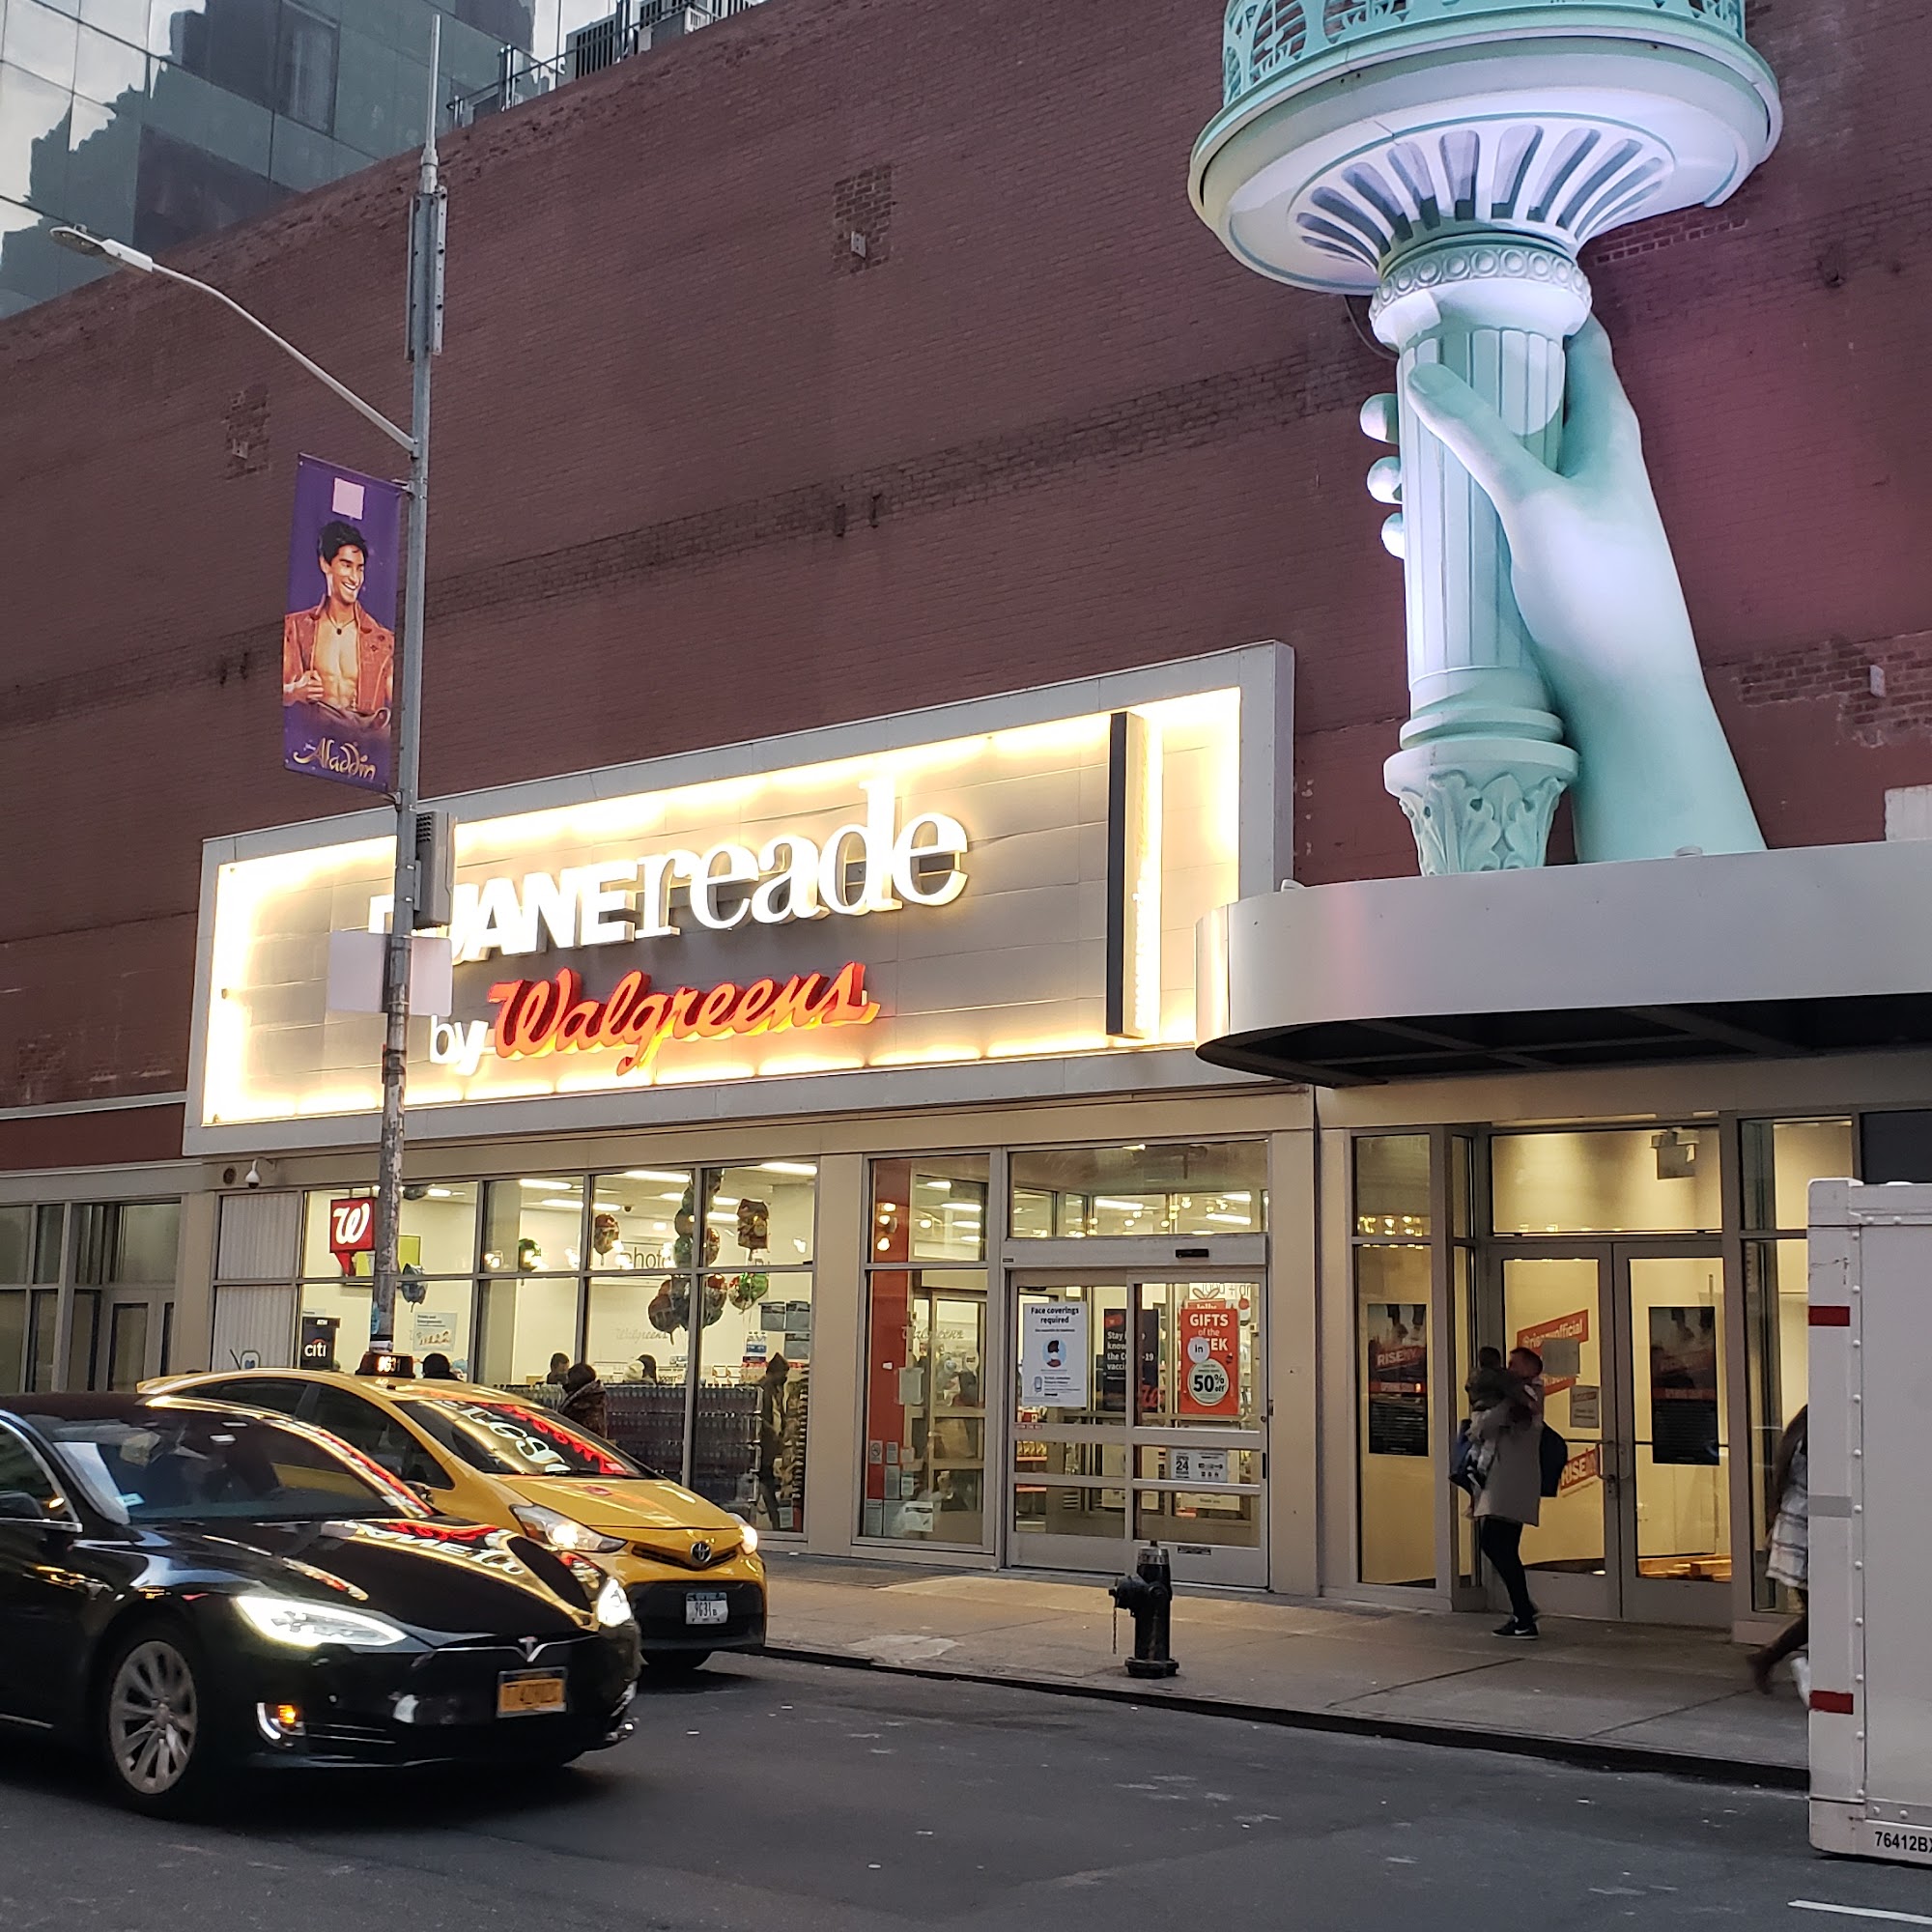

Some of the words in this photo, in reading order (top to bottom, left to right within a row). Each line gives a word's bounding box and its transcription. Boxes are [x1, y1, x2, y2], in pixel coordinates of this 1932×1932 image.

[293, 737, 377, 780] Aladdin
[430, 1015, 488, 1076] by
[488, 961, 880, 1076] Walgreens
[332, 1203, 370, 1245] W
[1047, 1306, 1079, 1315] coverings
[1040, 1316, 1069, 1324] required
[1190, 1314, 1229, 1326] GIFTS
[1107, 1331, 1123, 1341] Stay
[304, 1342, 327, 1357] citi
[1190, 1338, 1229, 1351] EK
[1176, 1460, 1189, 1470] 24
[1874, 1831, 1932, 1854] 76412B
